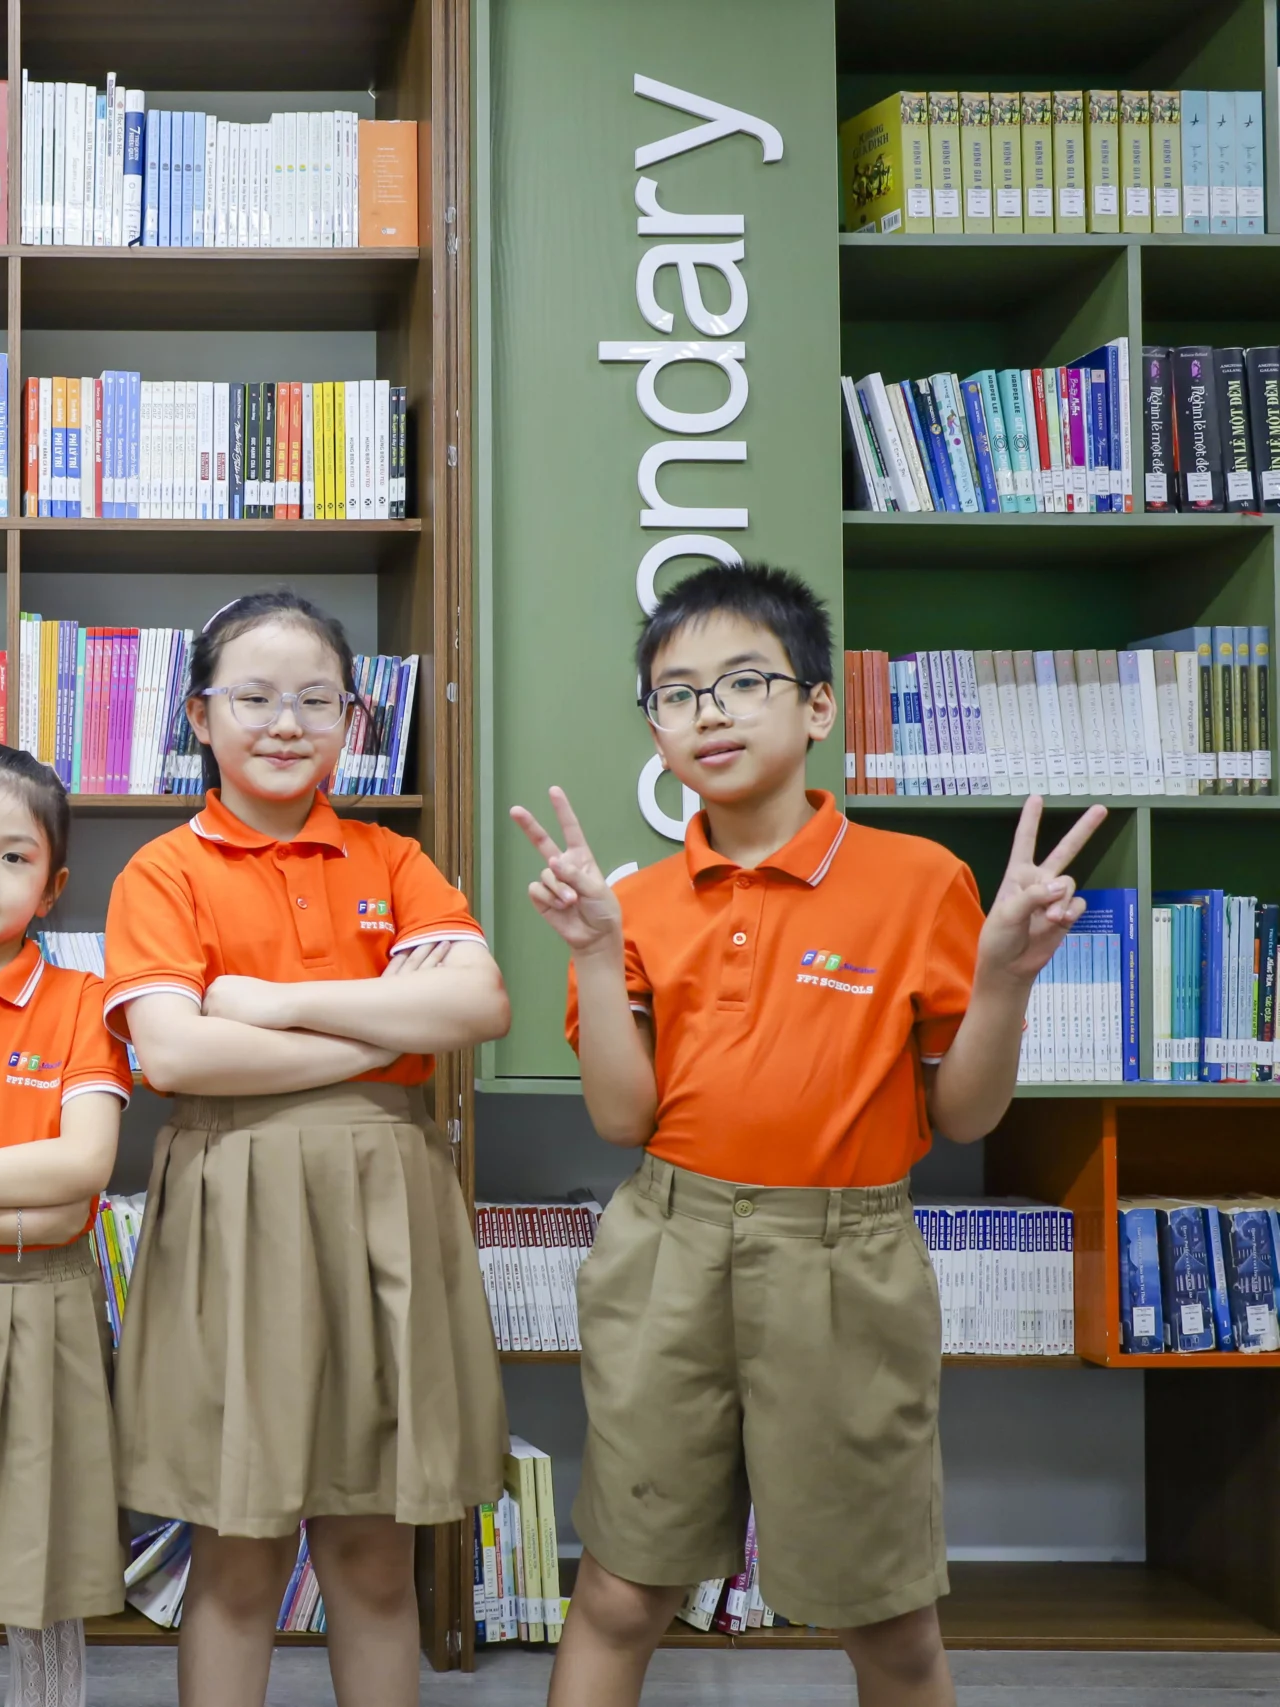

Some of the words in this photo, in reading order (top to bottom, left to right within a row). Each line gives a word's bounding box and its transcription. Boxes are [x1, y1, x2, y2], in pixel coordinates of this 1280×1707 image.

[129, 126, 140, 135] 7
[987, 375, 996, 401] HARPER
[1010, 374, 1018, 400] HARPER
[1227, 380, 1243, 406] ĐÊM
[1264, 380, 1278, 406] ĐÊM
[1229, 408, 1246, 436] MỘT
[1266, 408, 1280, 436] MỘT
[1152, 458, 1164, 474] đê
[1196, 458, 1210, 472] đê
[359, 902, 387, 914] FPT
[803, 952, 840, 967] FPT
[796, 974, 819, 985] FPT
[820, 977, 874, 994] SCHOOLS
[9, 1054, 40, 1069] FPT
